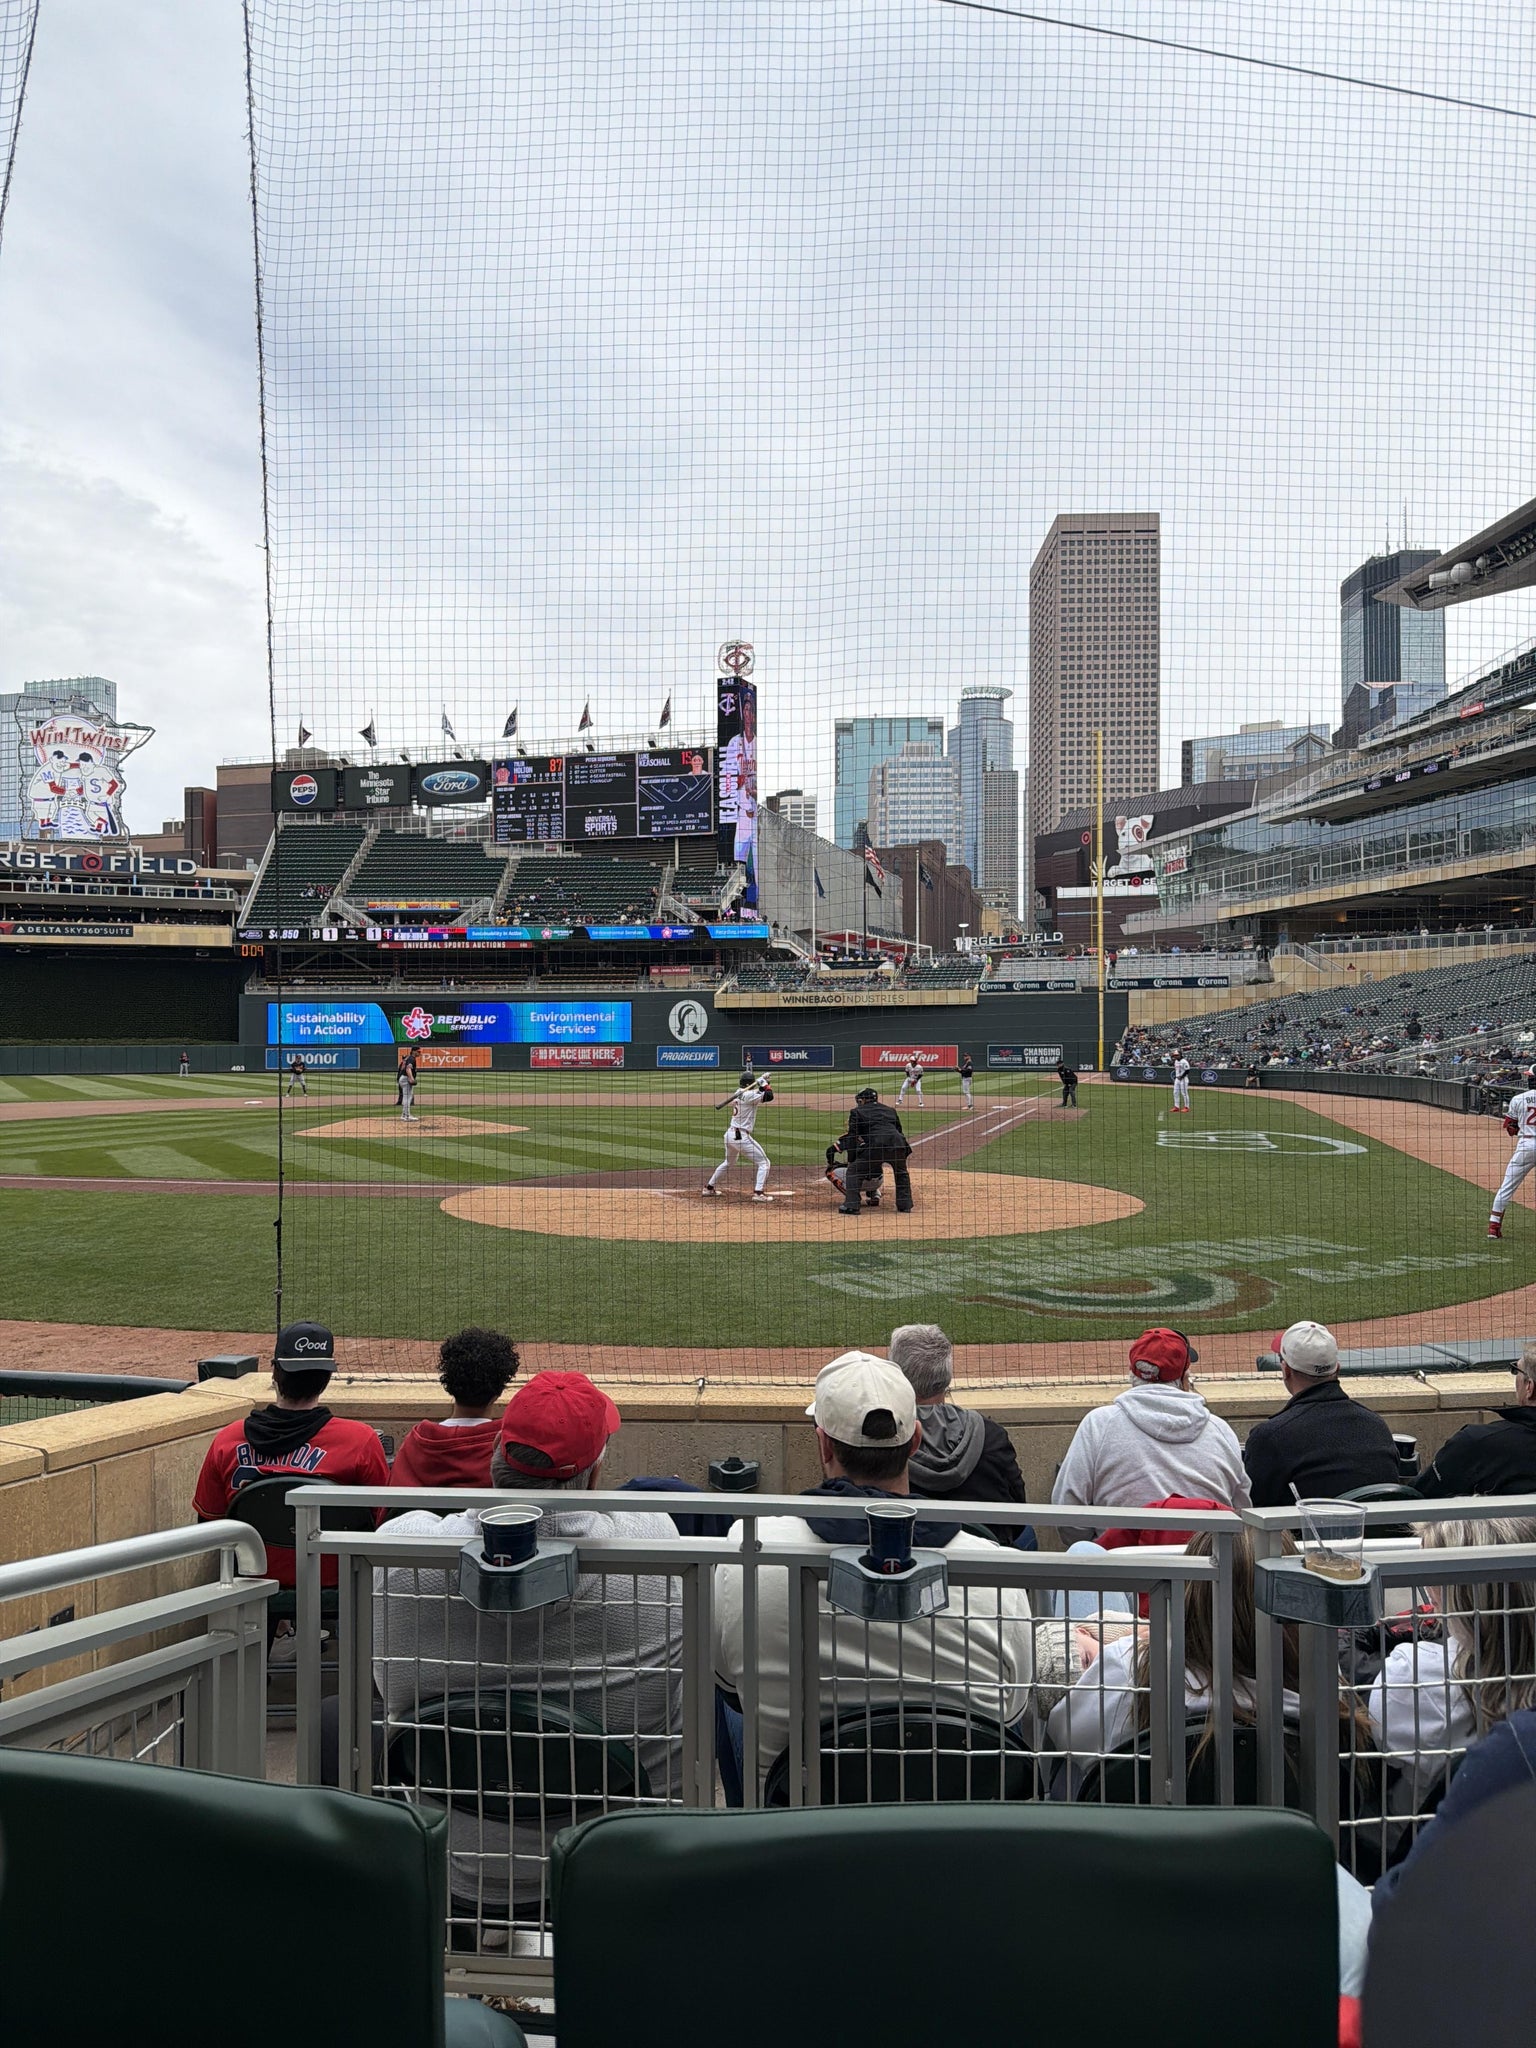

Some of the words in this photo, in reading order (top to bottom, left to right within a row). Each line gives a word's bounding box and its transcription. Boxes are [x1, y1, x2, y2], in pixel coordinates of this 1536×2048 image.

[29, 726, 71, 746] Win!
[72, 726, 130, 751] Twins!
[550, 758, 562, 772] 87
[368, 771, 380, 780] The
[89, 778, 102, 794] S
[360, 778, 394, 788] Minnesota
[432, 774, 467, 794] Ford
[291, 785, 317, 795] PEPSI
[374, 787, 390, 796] Star
[365, 794, 390, 804] Tribune
[585, 815, 617, 823] UNIVERSAL
[585, 822, 617, 832] SPORTS
[110, 855, 198, 875] FIELD
[1091, 879, 1130, 888] TRGET
[27, 926, 61, 934] DELTA
[103, 927, 130, 935] SUITE
[1022, 932, 1063, 942] FIELD
[979, 982, 1007, 991] Corona
[1013, 981, 1040, 990] Corona
[1046, 980, 1074, 990] Corona
[1109, 980, 1138, 989] Corona
[1153, 979, 1183, 988] Corona
[1197, 977, 1228, 987] Corona
[782, 995, 841, 1004] WINNEBAGO
[842, 994, 905, 1003] INDUSTRIES
[286, 1012, 366, 1026] Sustainability
[437, 1015, 497, 1024] REPUBLIC
[530, 1011, 615, 1022] Environmental
[300, 1025, 311, 1035] in
[313, 1025, 352, 1035] Action
[548, 1023, 597, 1034] Services
[548, 1049, 577, 1060] PLACE
[592, 1049, 616, 1060] HERE
[1023, 1047, 1061, 1056] CHANGING
[421, 1053, 468, 1066] Paycor
[660, 1052, 717, 1062] PROGRESSIVE
[1025, 1056, 1038, 1064] THE
[294, 1336, 328, 1353] Good
